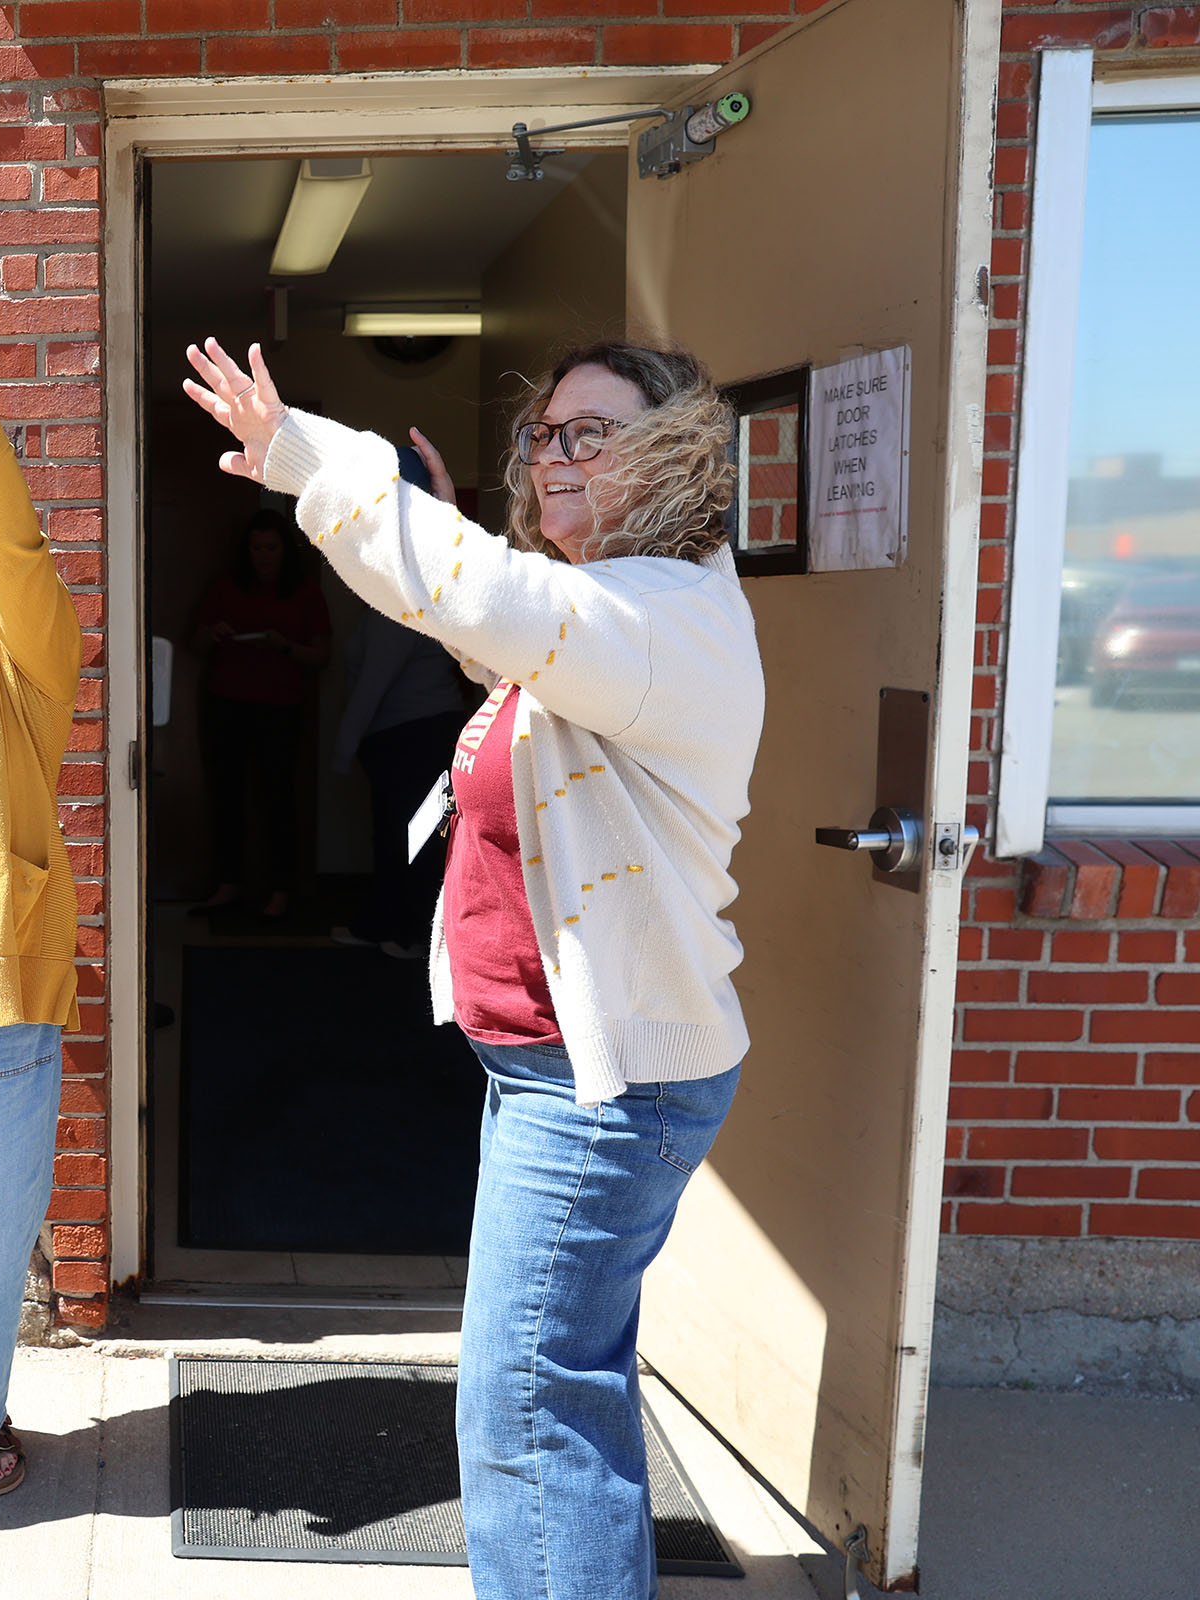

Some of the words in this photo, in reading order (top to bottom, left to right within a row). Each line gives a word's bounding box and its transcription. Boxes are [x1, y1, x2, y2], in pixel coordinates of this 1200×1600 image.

[824, 384, 854, 404] MAKE
[856, 375, 887, 397] SURE
[837, 405, 870, 426] DOOR
[829, 429, 877, 452] LATCHES
[834, 456, 867, 476] WHEN
